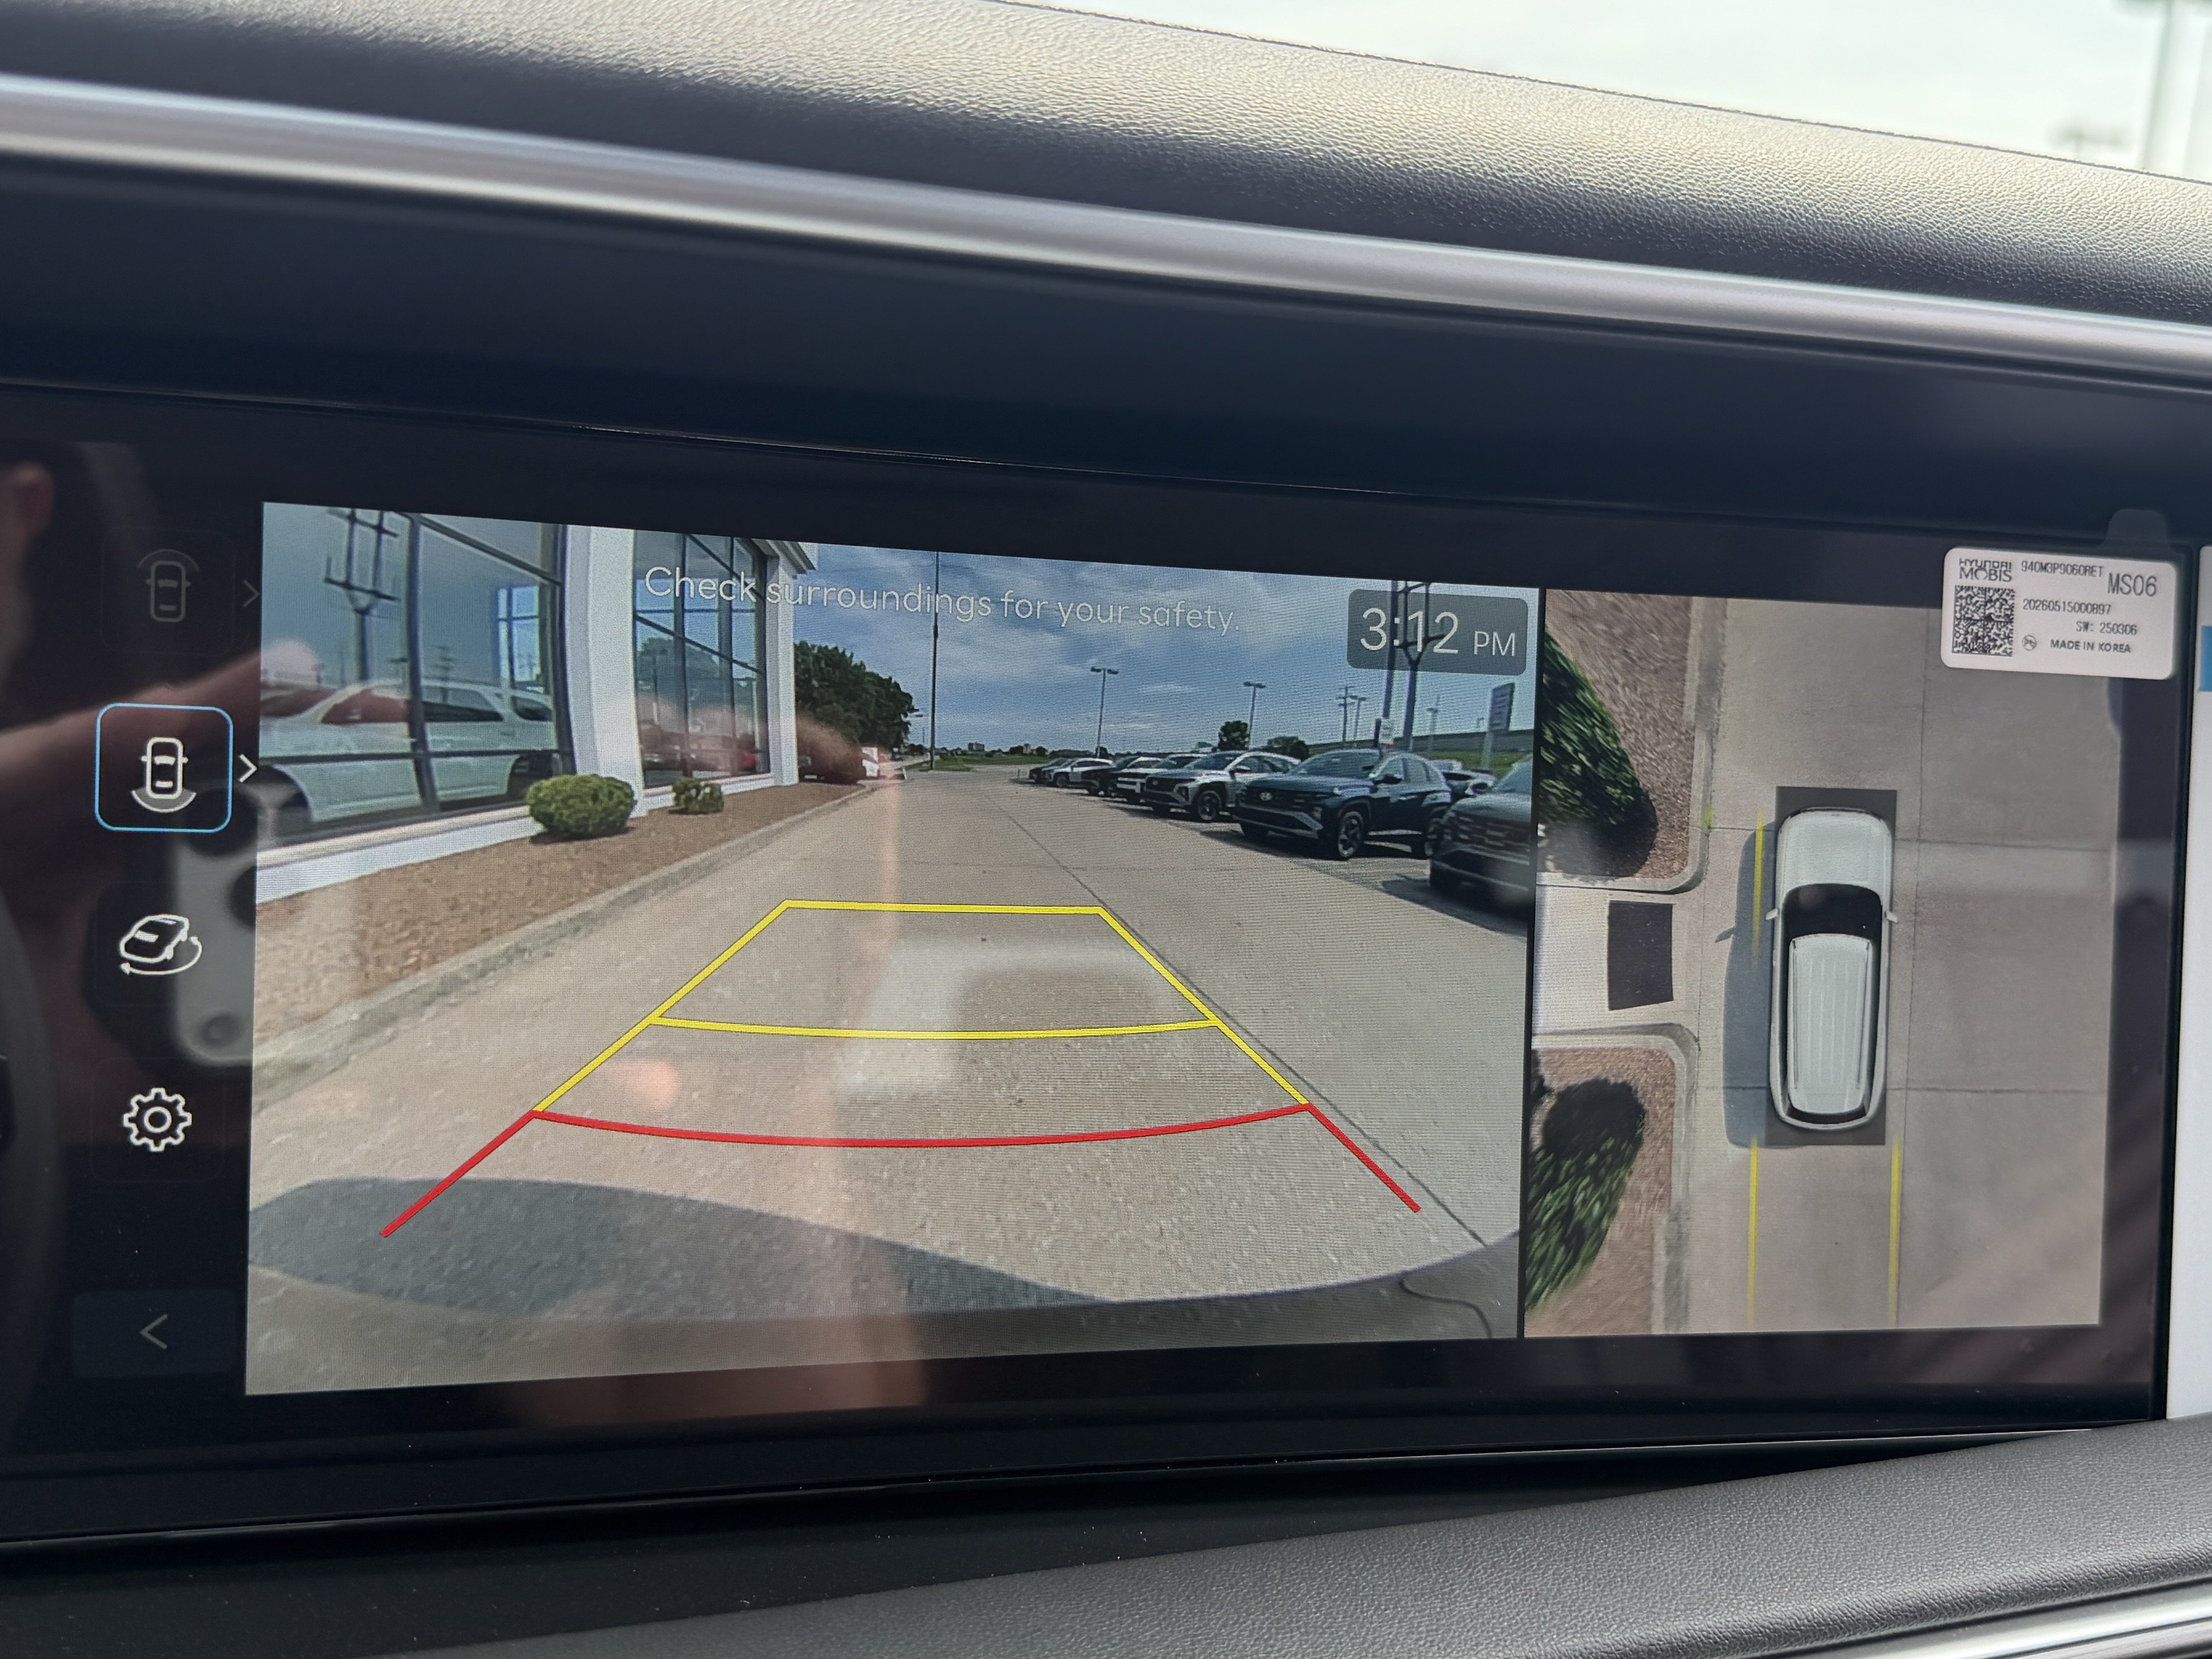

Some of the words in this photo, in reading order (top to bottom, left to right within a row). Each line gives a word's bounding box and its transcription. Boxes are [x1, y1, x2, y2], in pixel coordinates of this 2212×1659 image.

[1959, 558, 2012, 570] HYUNDAI
[1959, 566, 2013, 583] MOBIS
[2107, 572, 2158, 597] MS06
[645, 566, 757, 603] Check
[766, 581, 992, 622] surroundings
[1000, 589, 1049, 619] for
[1058, 601, 1130, 627] your
[1138, 600, 1239, 636] safety.
[2023, 598, 2112, 615] 20260515000897
[1360, 607, 1459, 654] 3:12
[1473, 630, 1516, 657] PM
[2075, 620, 2094, 632] SW:
[2099, 623, 2137, 636] 250306
[2050, 639, 2081, 650] MADE
[2083, 641, 2094, 651] IN
[2098, 642, 2132, 654] KOREA
